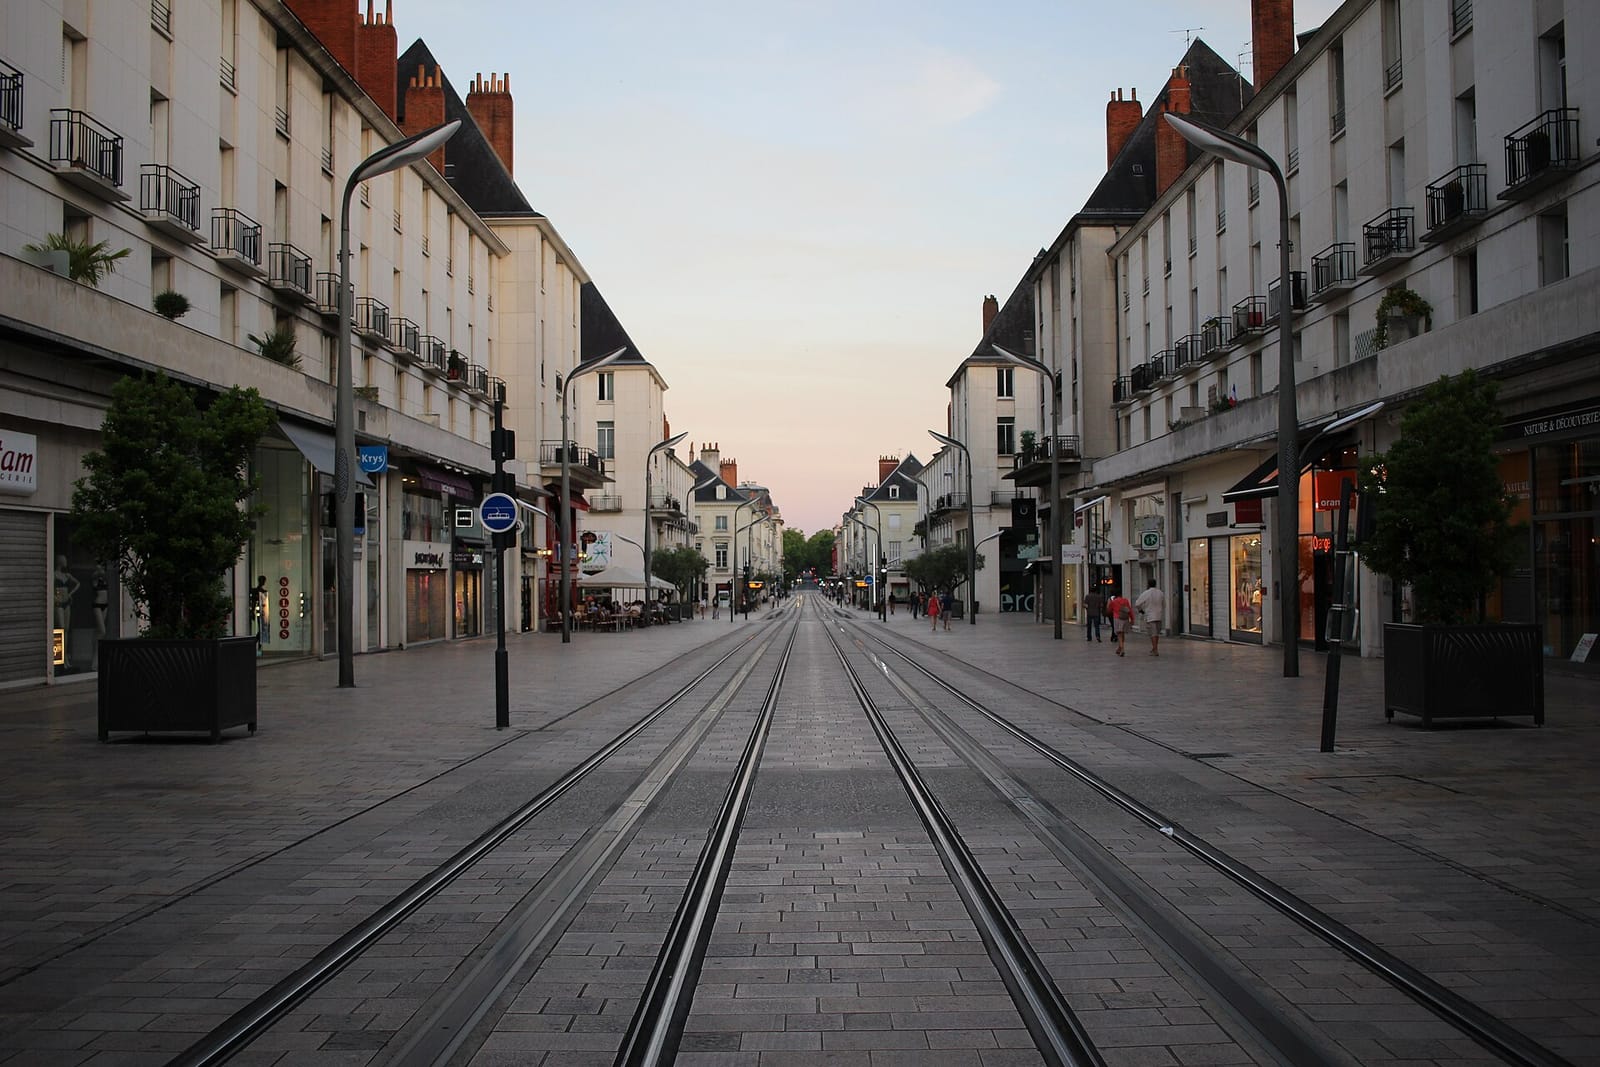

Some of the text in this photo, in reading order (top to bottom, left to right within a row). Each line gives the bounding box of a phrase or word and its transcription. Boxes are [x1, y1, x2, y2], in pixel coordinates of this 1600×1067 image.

[1524, 421, 1549, 436] NATURE
[361, 454, 383, 465] Krys
[1312, 536, 1331, 552] Orange
[279, 577, 289, 639] SOLDES
